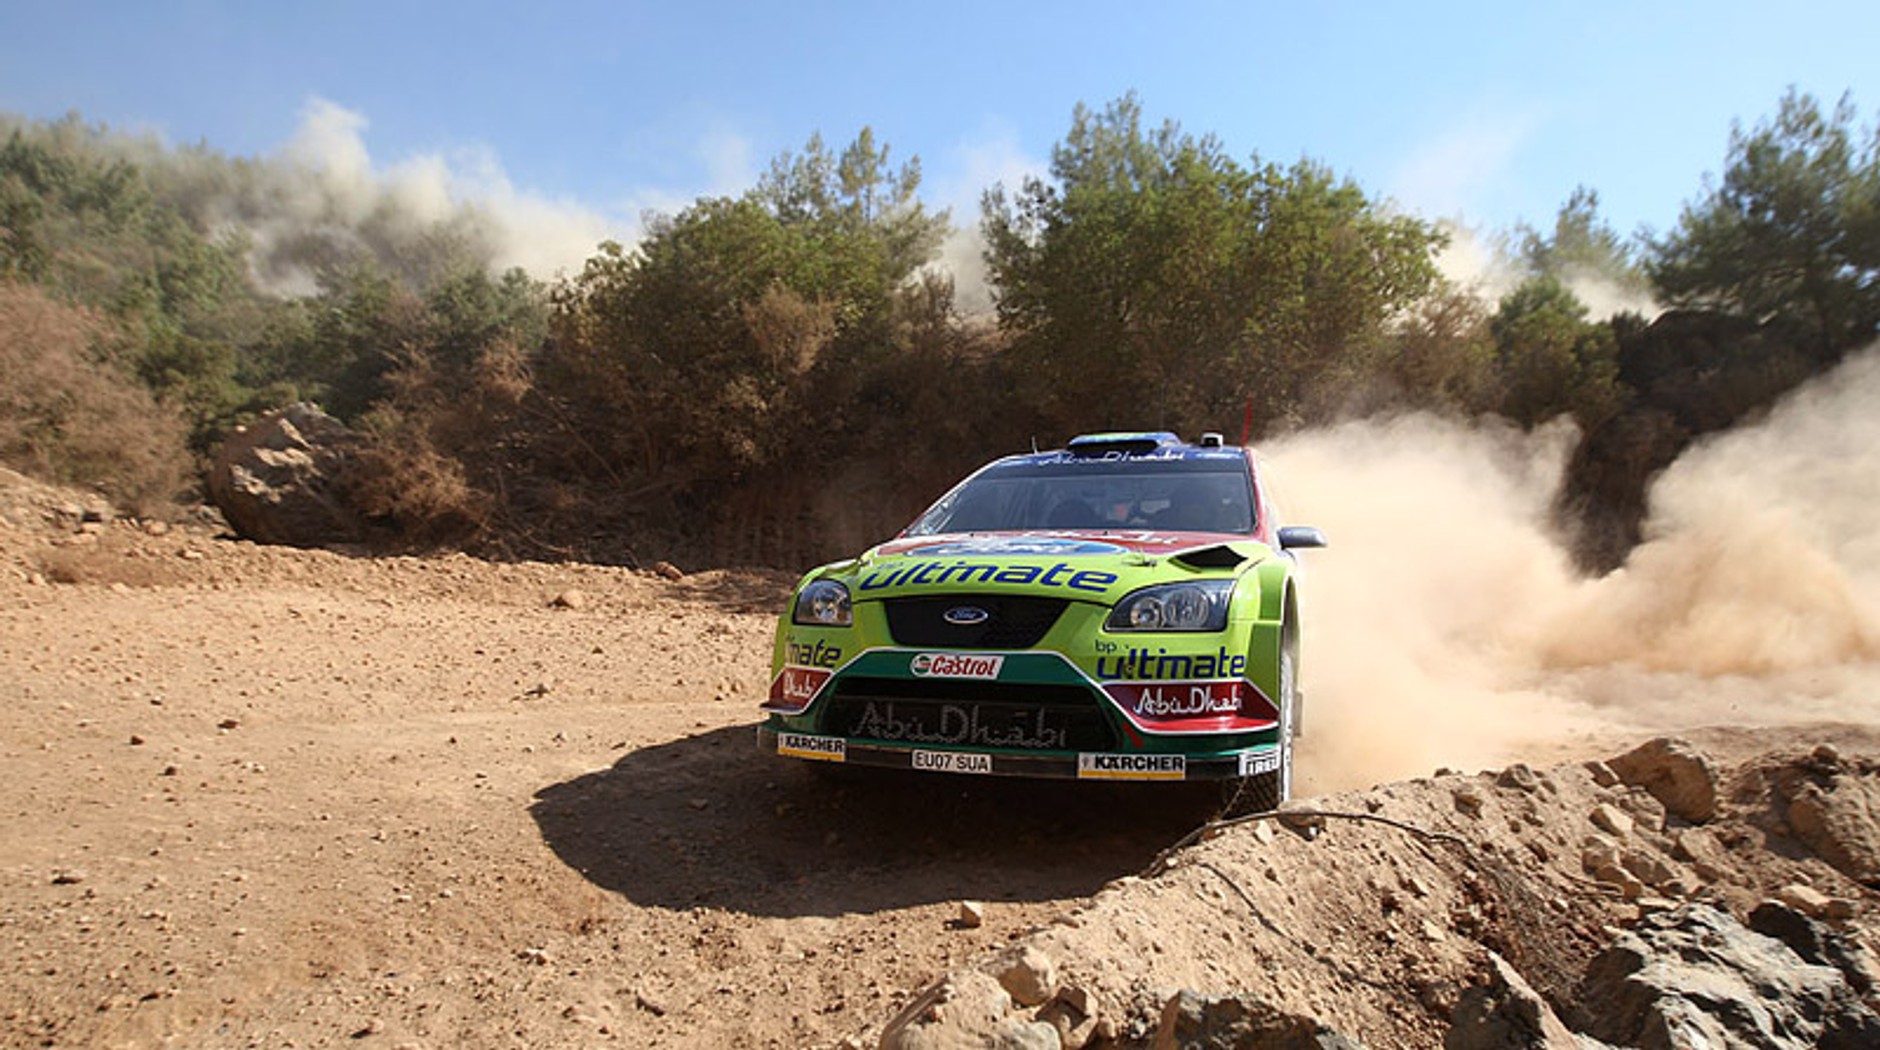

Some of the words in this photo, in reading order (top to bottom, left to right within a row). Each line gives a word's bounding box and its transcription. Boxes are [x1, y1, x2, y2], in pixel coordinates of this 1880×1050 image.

[859, 560, 1118, 592] ultimate
[1094, 638, 1118, 654] bp
[931, 655, 996, 677] Castrol
[1097, 646, 1246, 680] ultimate
[1133, 687, 1186, 715] Abu
[1190, 685, 1243, 714] Dhabi
[852, 702, 934, 741] Abu
[940, 704, 1068, 748] Dhabi
[914, 752, 952, 769] EU07
[955, 754, 989, 772] SUA
